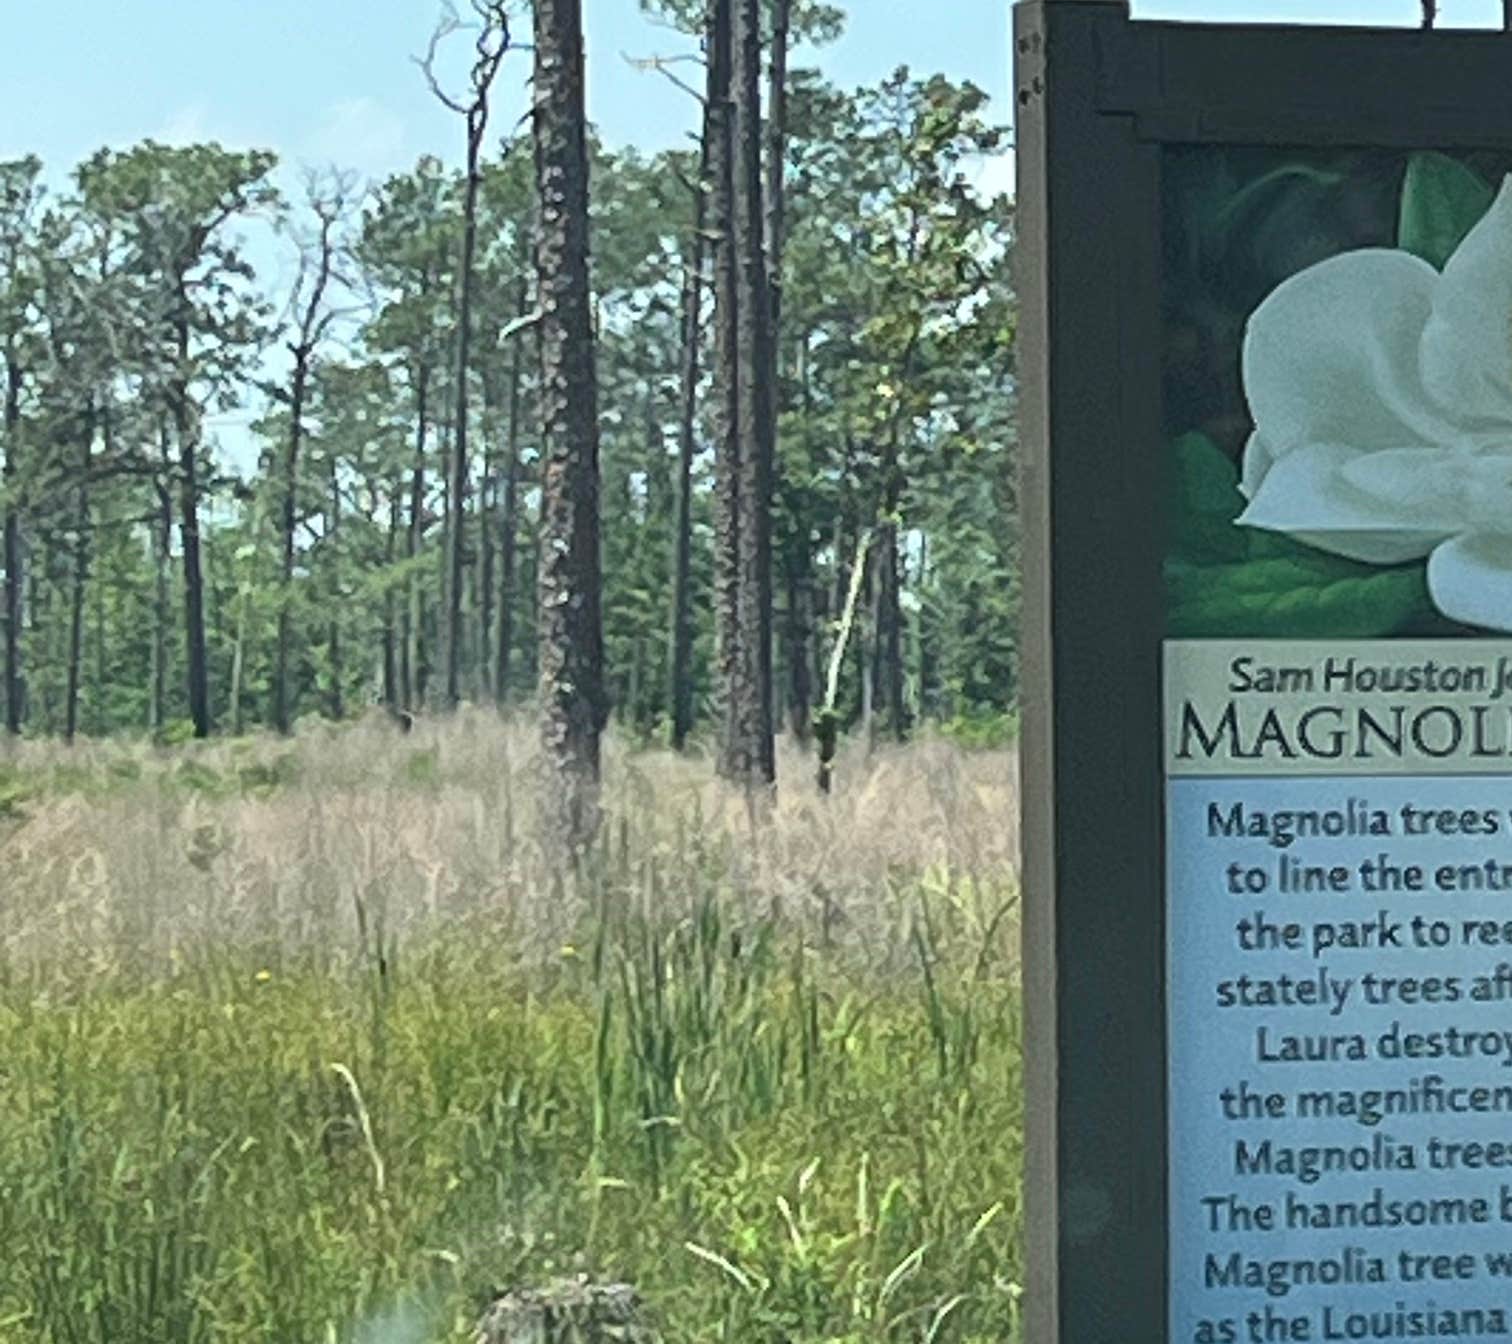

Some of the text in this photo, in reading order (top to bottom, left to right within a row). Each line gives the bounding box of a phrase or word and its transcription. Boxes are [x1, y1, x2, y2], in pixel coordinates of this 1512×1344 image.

[1229, 658, 1312, 695] Sam
[1323, 656, 1484, 694] Houston
[1206, 802, 1391, 847] Magnolia
[1401, 803, 1499, 834] trees
[1225, 862, 1267, 894] to
[1278, 856, 1350, 893] line
[1358, 856, 1422, 892] the
[1237, 915, 1301, 951] the
[1312, 911, 1401, 956] park
[1411, 915, 1450, 947] to
[1215, 968, 1353, 1015] stately
[1362, 972, 1461, 1003] trees
[1256, 1027, 1366, 1063] Laura
[1219, 1082, 1285, 1119] the
[1233, 1136, 1416, 1183] Magnolia
[1202, 1195, 1273, 1232] The
[1286, 1189, 1490, 1230] handsome
[1203, 1248, 1386, 1296] Magnolia
[1399, 1249, 1474, 1281] tree
[1247, 1306, 1310, 1342] the
[1322, 1303, 1508, 1340] Louisiana
